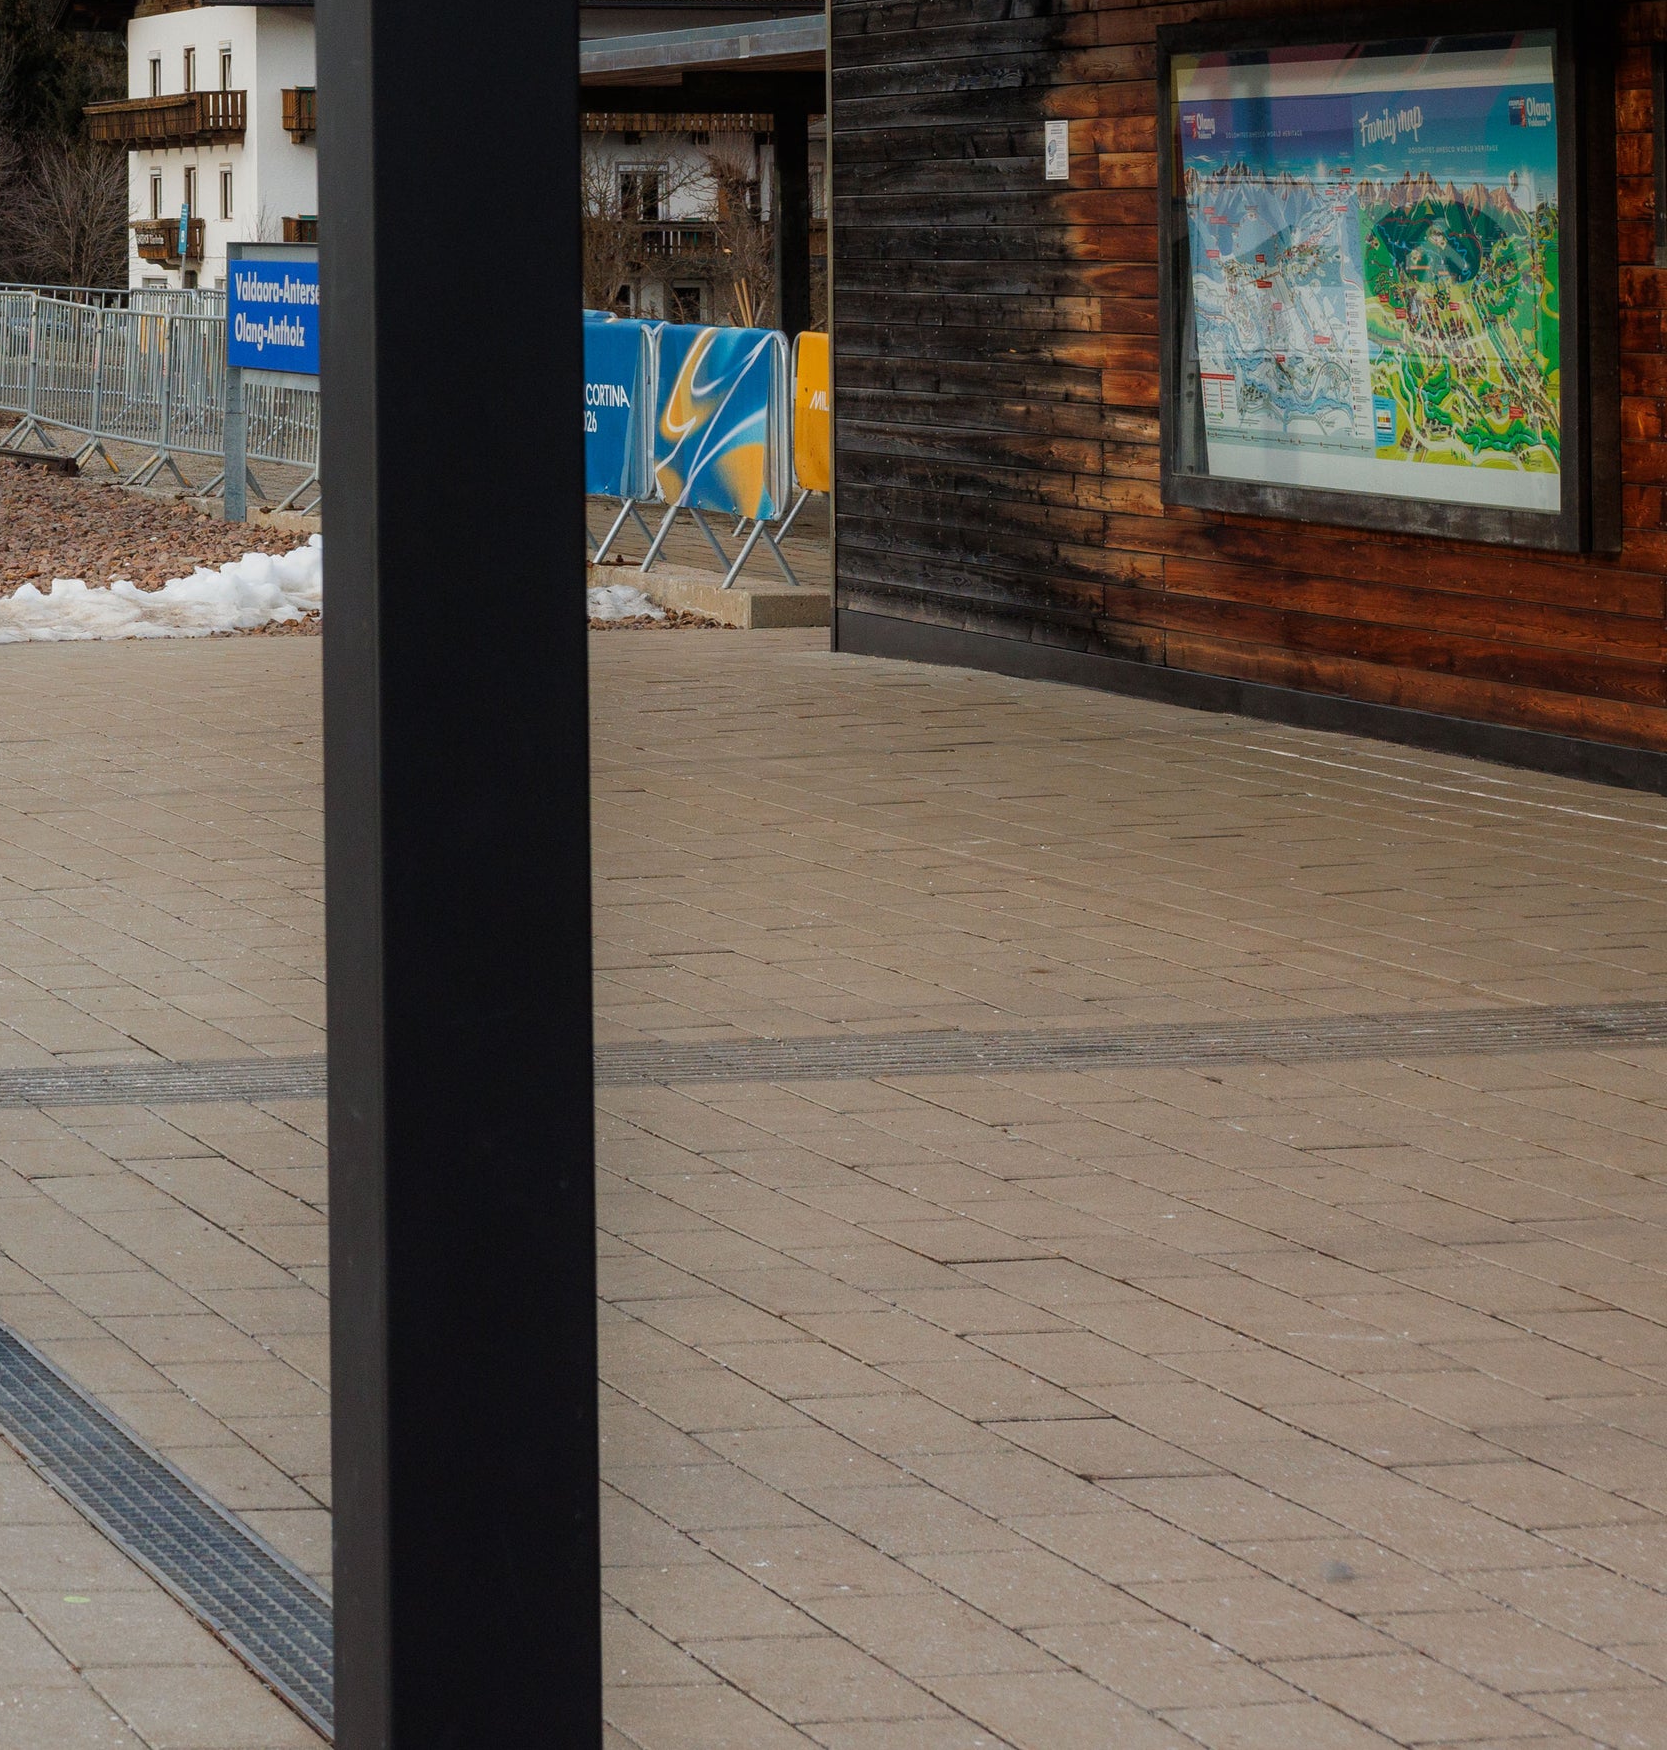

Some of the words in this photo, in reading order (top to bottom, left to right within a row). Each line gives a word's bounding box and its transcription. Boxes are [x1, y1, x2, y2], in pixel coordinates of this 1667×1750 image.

[1526, 97, 1552, 122] Olang
[1358, 108, 1396, 148] Family
[1397, 105, 1424, 142] map
[235, 312, 305, 352] Olang-Antholz
[586, 383, 630, 408] CORTINA
